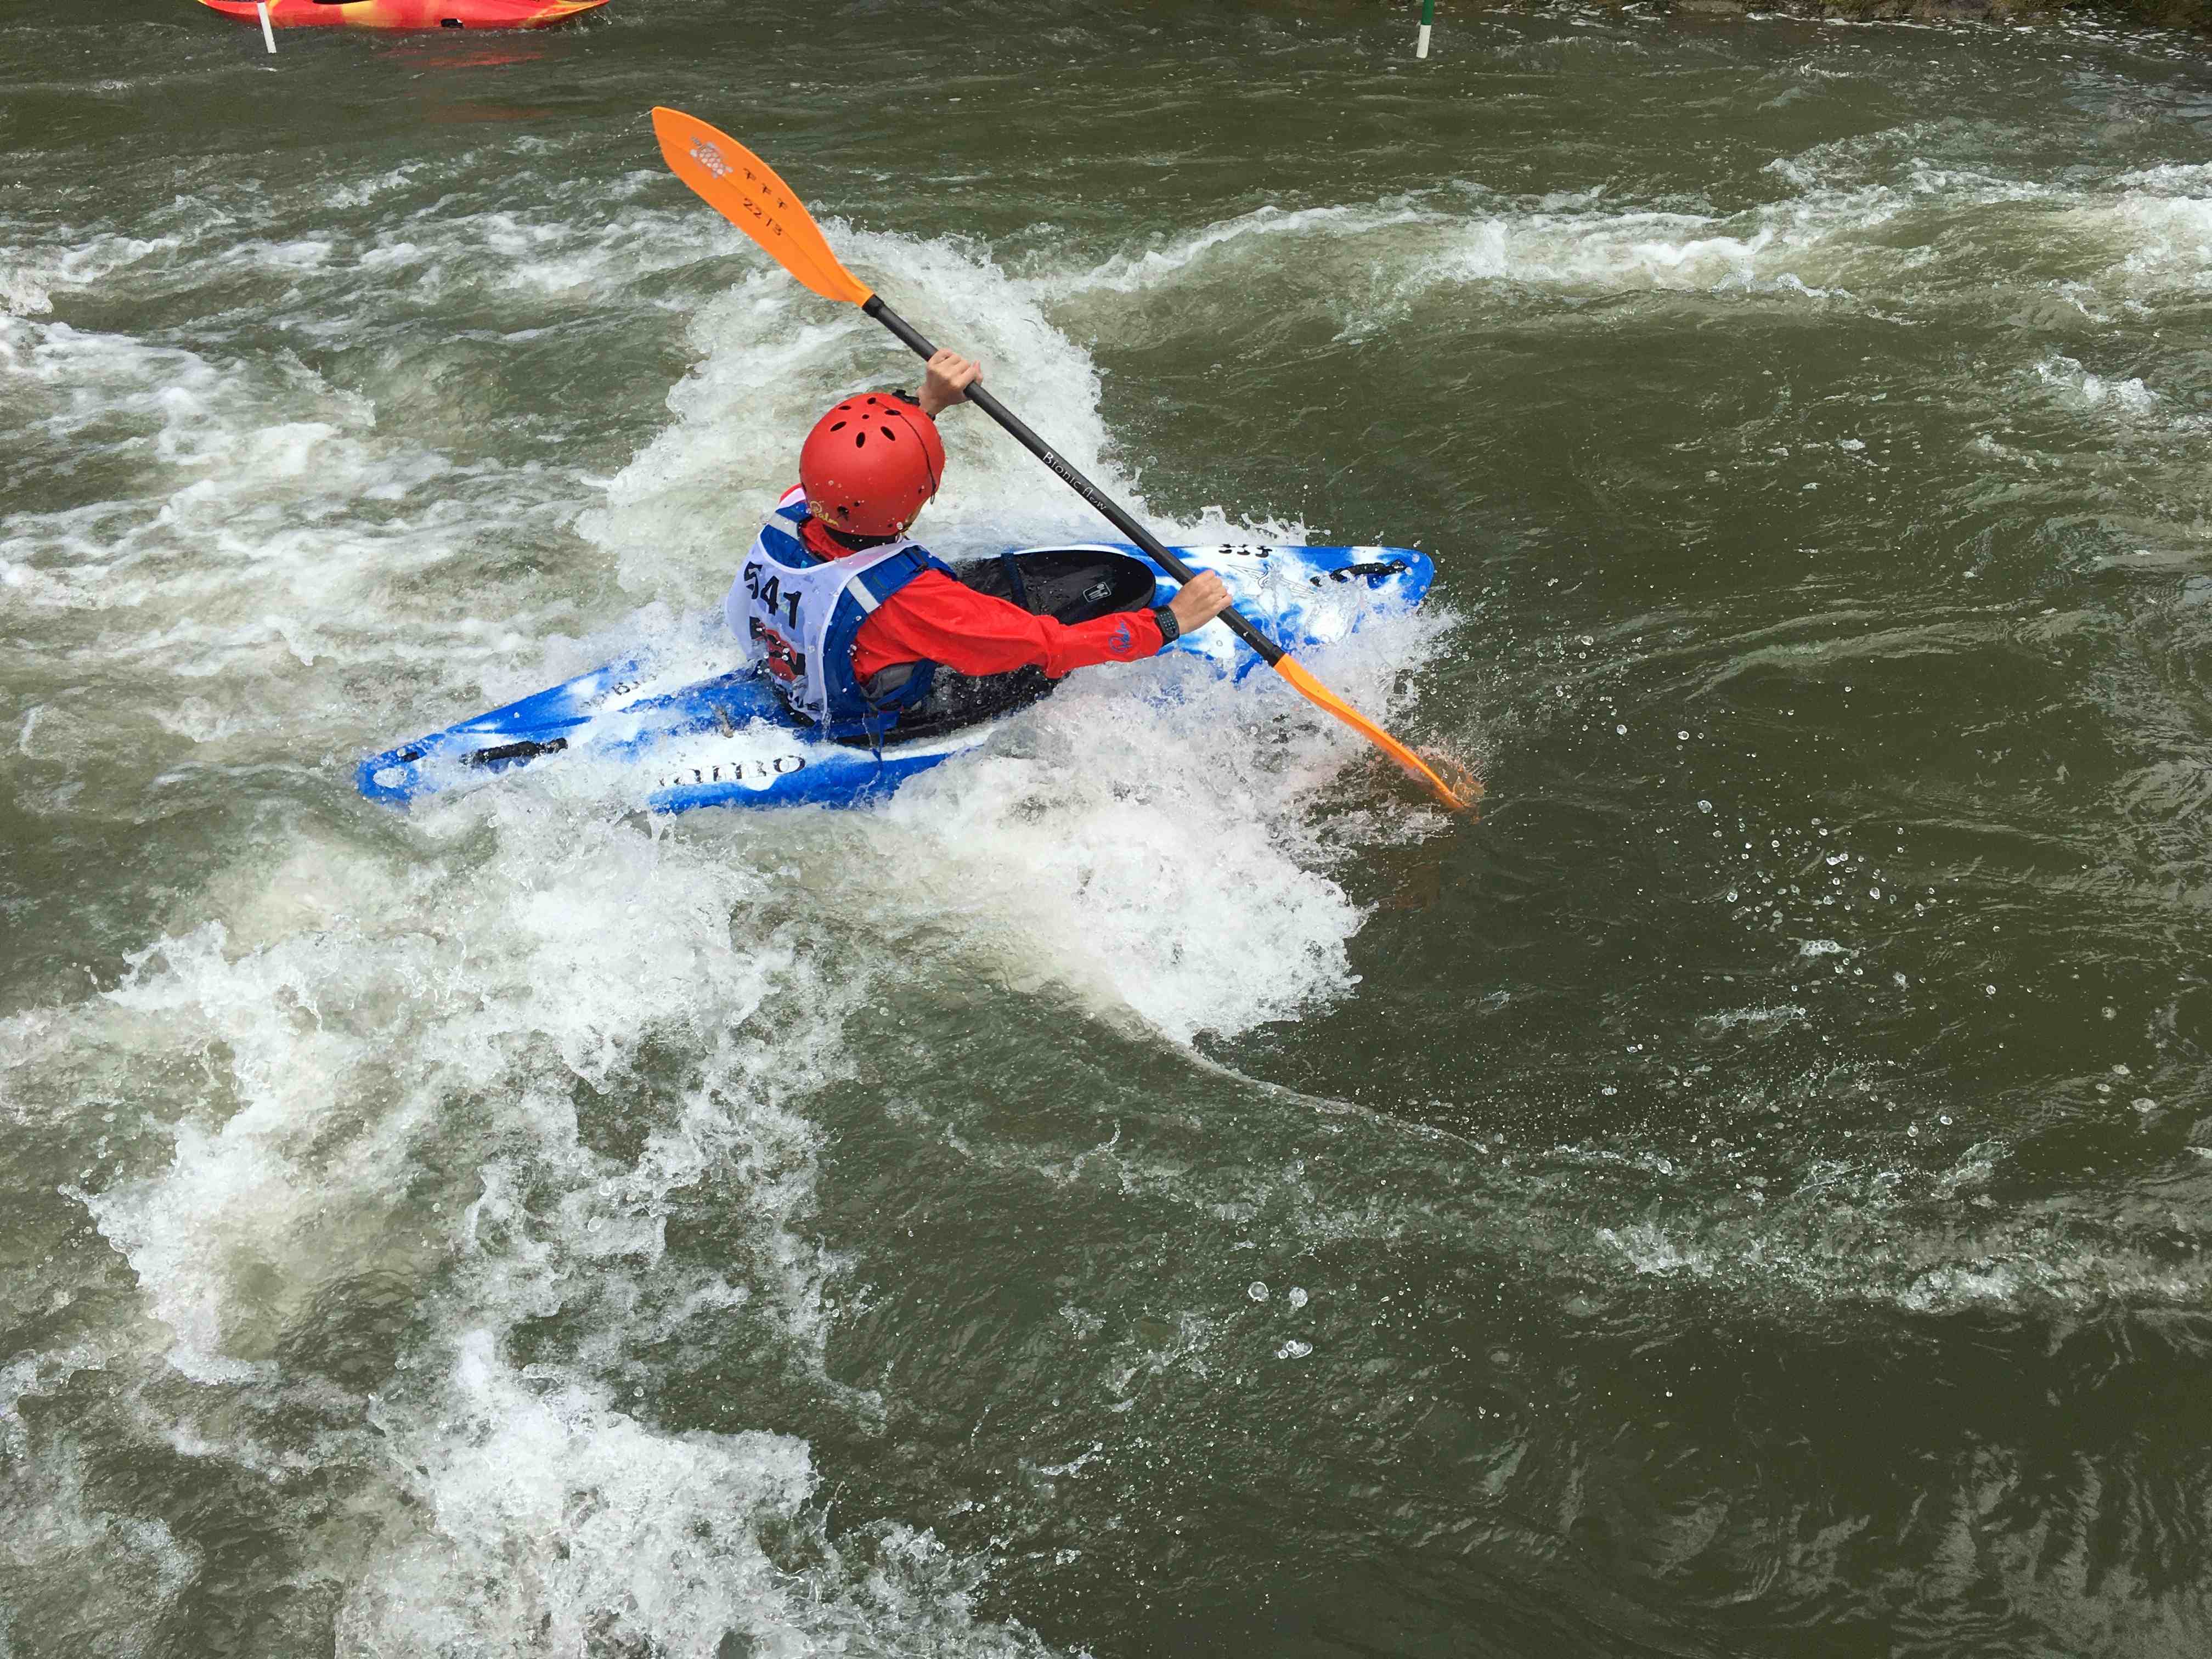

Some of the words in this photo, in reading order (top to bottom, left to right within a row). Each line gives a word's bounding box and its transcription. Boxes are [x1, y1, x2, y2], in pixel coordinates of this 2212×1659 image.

[743, 198, 782, 236] 2213
[1042, 451, 1081, 489] Bionic
[743, 561, 802, 630] 541
